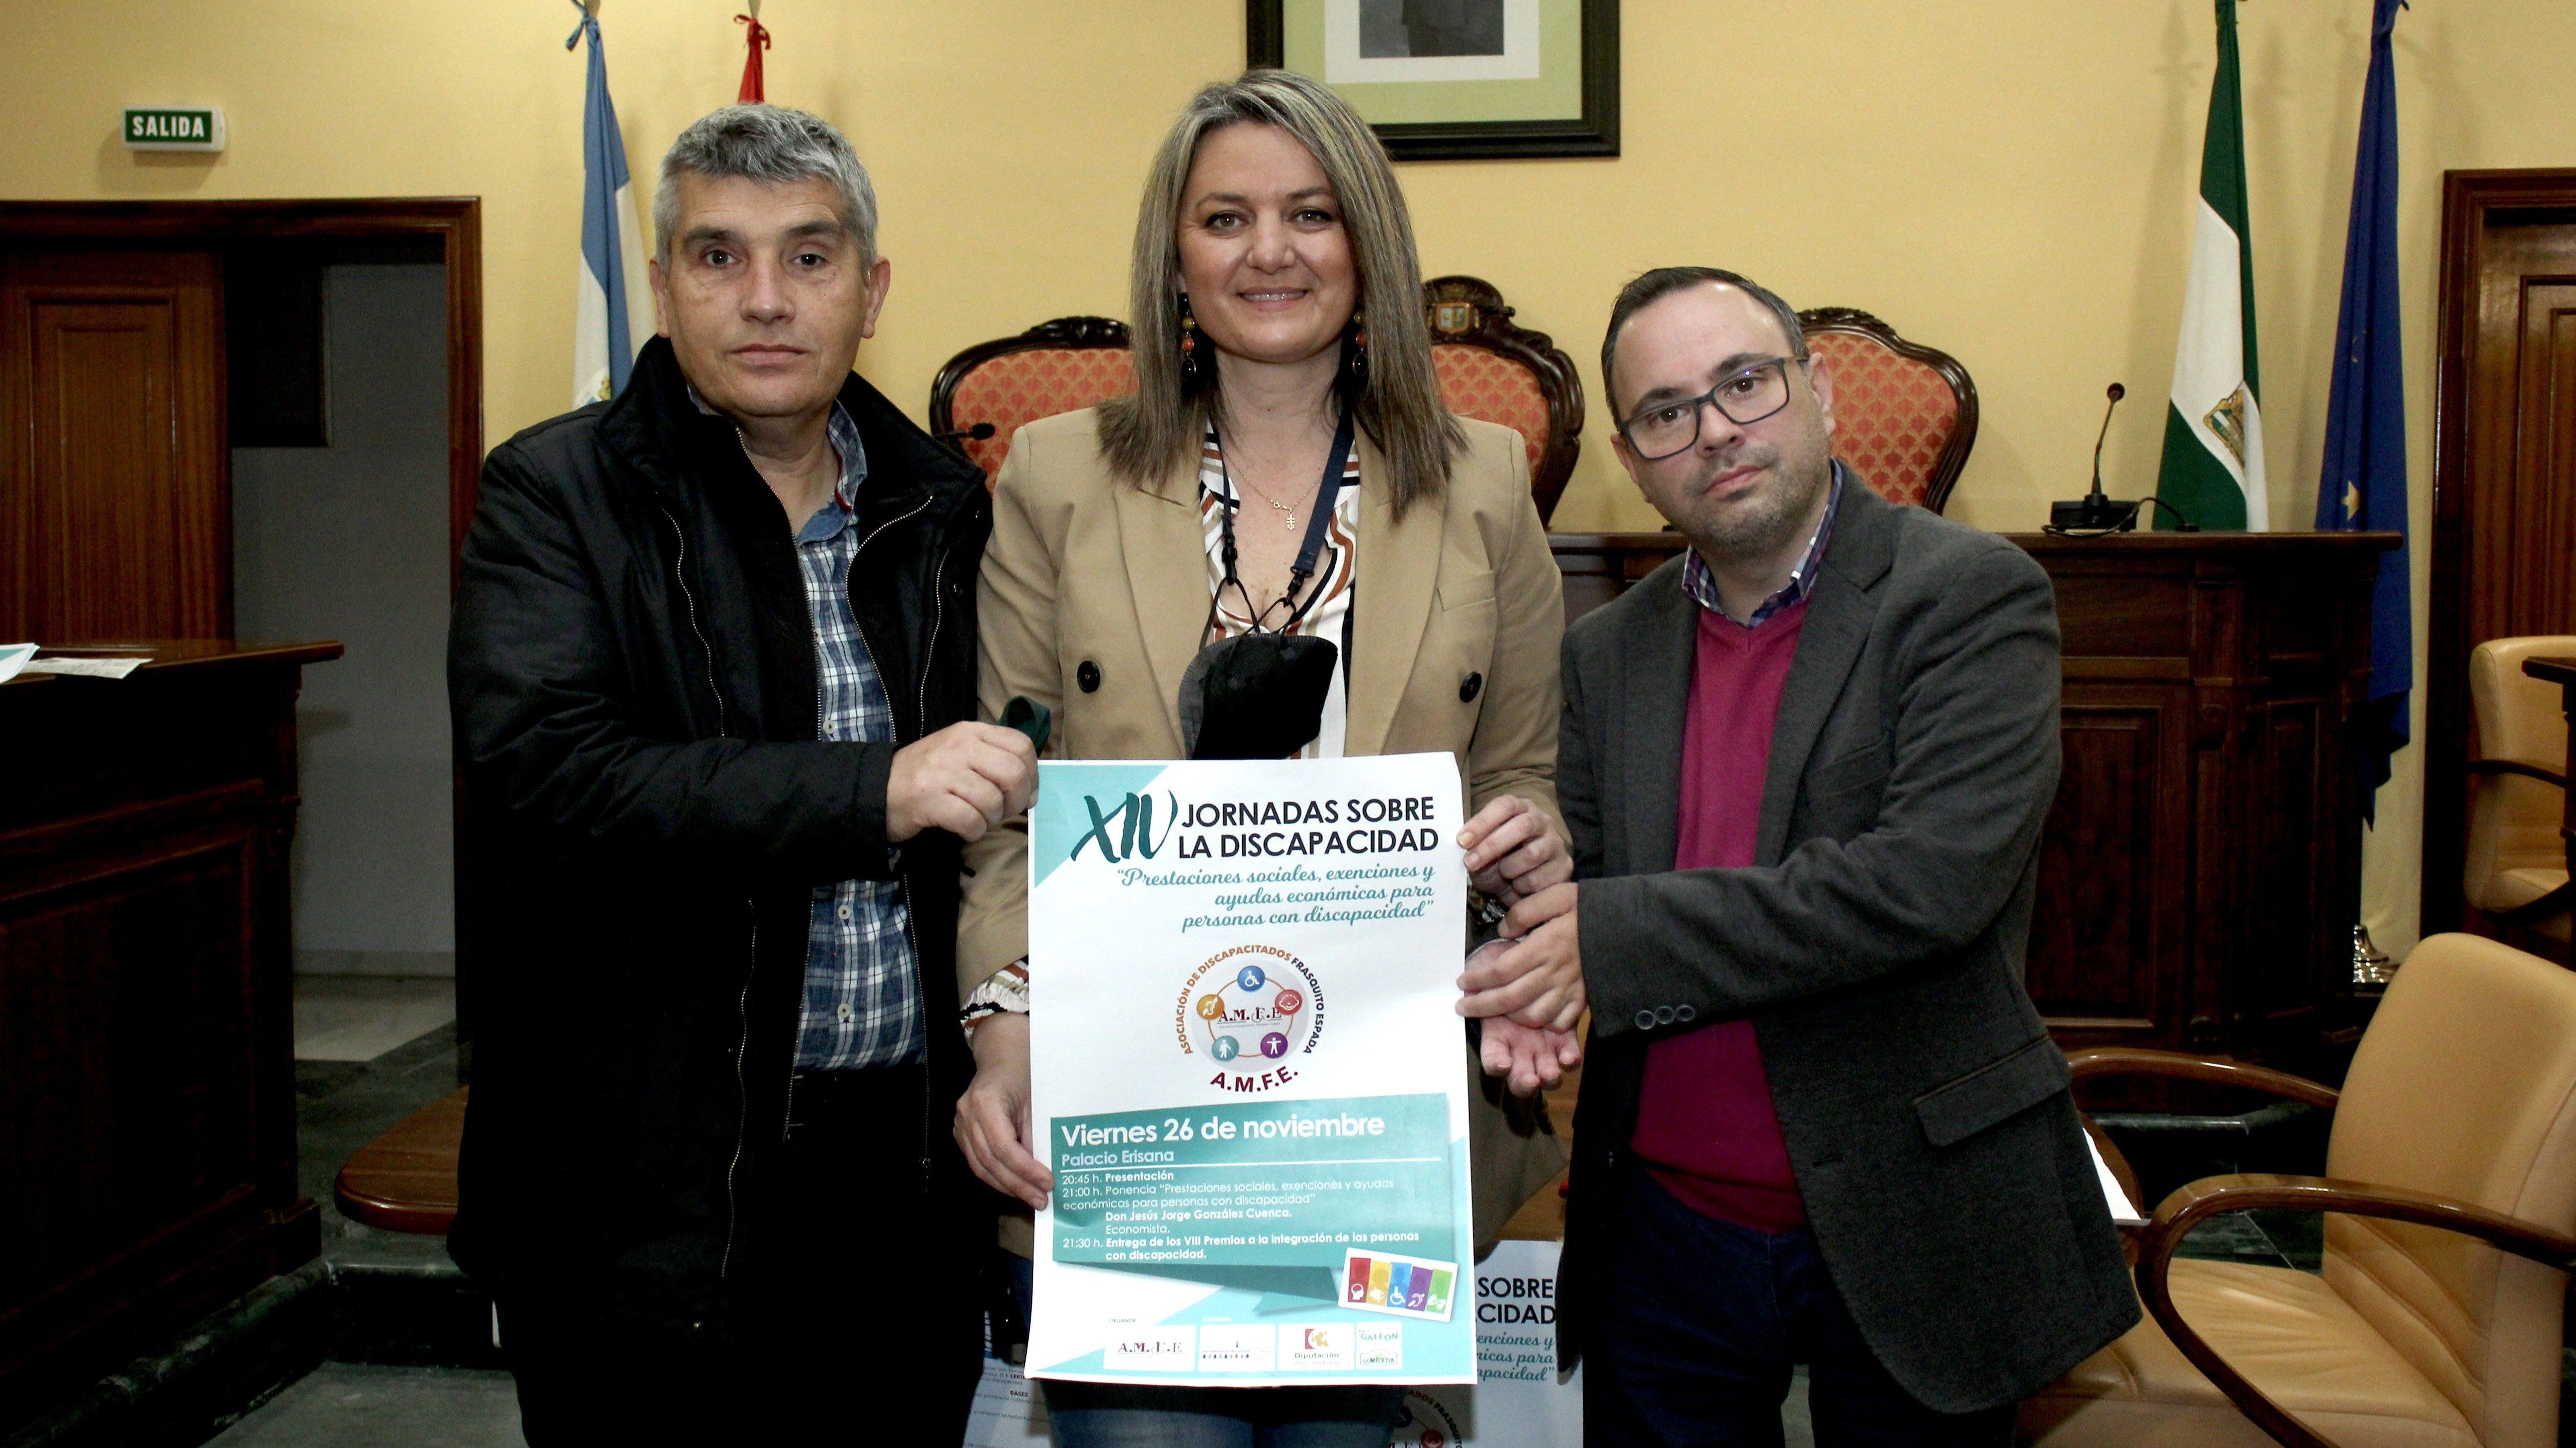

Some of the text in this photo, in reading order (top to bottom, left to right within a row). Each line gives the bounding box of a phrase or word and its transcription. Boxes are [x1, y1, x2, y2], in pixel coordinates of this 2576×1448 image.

[132, 116, 204, 138] SALIDA
[1182, 796, 1435, 827] JORNADAS SOBRE
[1071, 790, 1178, 863] XIV
[1179, 828, 1439, 859] LA DISCAPACIDAD
[1247, 865, 1322, 883] sociales,
[1326, 865, 1419, 880] exenciones
[1422, 867, 1435, 881] y
[1215, 883, 1434, 911] ayudas económicas para
[1182, 913, 1265, 933] personas
[1269, 912, 1300, 924] con
[1176, 945, 1292, 1055] ASOCIACIÓN DE DISCAPACITADOS
[1290, 957, 1324, 1054] FRASQUITO ESPADA
[1210, 1065, 1298, 1093] A.M.F.E.
[1061, 1113, 1385, 1147] Viernes 26 de noviembre
[1061, 1149, 1174, 1167] Palacio Erisana
[1062, 1170, 1174, 1185] 20:45 h. Presentación
[1062, 1188, 1090, 1198] 21:00
[1093, 1187, 1102, 1196] h.
[1106, 1185, 1156, 1195] Ponencia
[1234, 1180, 1279, 1192] sociales,
[1282, 1180, 1342, 1191] exenciones
[1346, 1181, 1351, 1191] y
[1354, 1179, 1394, 1190] ayudas
[1063, 1199, 1129, 1210] económicas
[1132, 1199, 1158, 1209] para
[1161, 1197, 1208, 1207] personas
[1211, 1197, 1232, 1206] con
[1106, 1208, 1292, 1222] Don Jesús Jorge González Cuenca.
[1106, 1223, 1170, 1234] Economista.
[1063, 1232, 1419, 1249] 21:30 h. Entrega de los VIII Premios a la integración de las personas
[1105, 1248, 1207, 1261] con discapacidad.
[1477, 1277, 1553, 1298] SOBRE
[1476, 1303, 1557, 1324] CIDAD
[1361, 1332, 1398, 1341] GALEÓN
[1544, 1336, 1554, 1351] y
[1517, 1354, 1554, 1368] para
